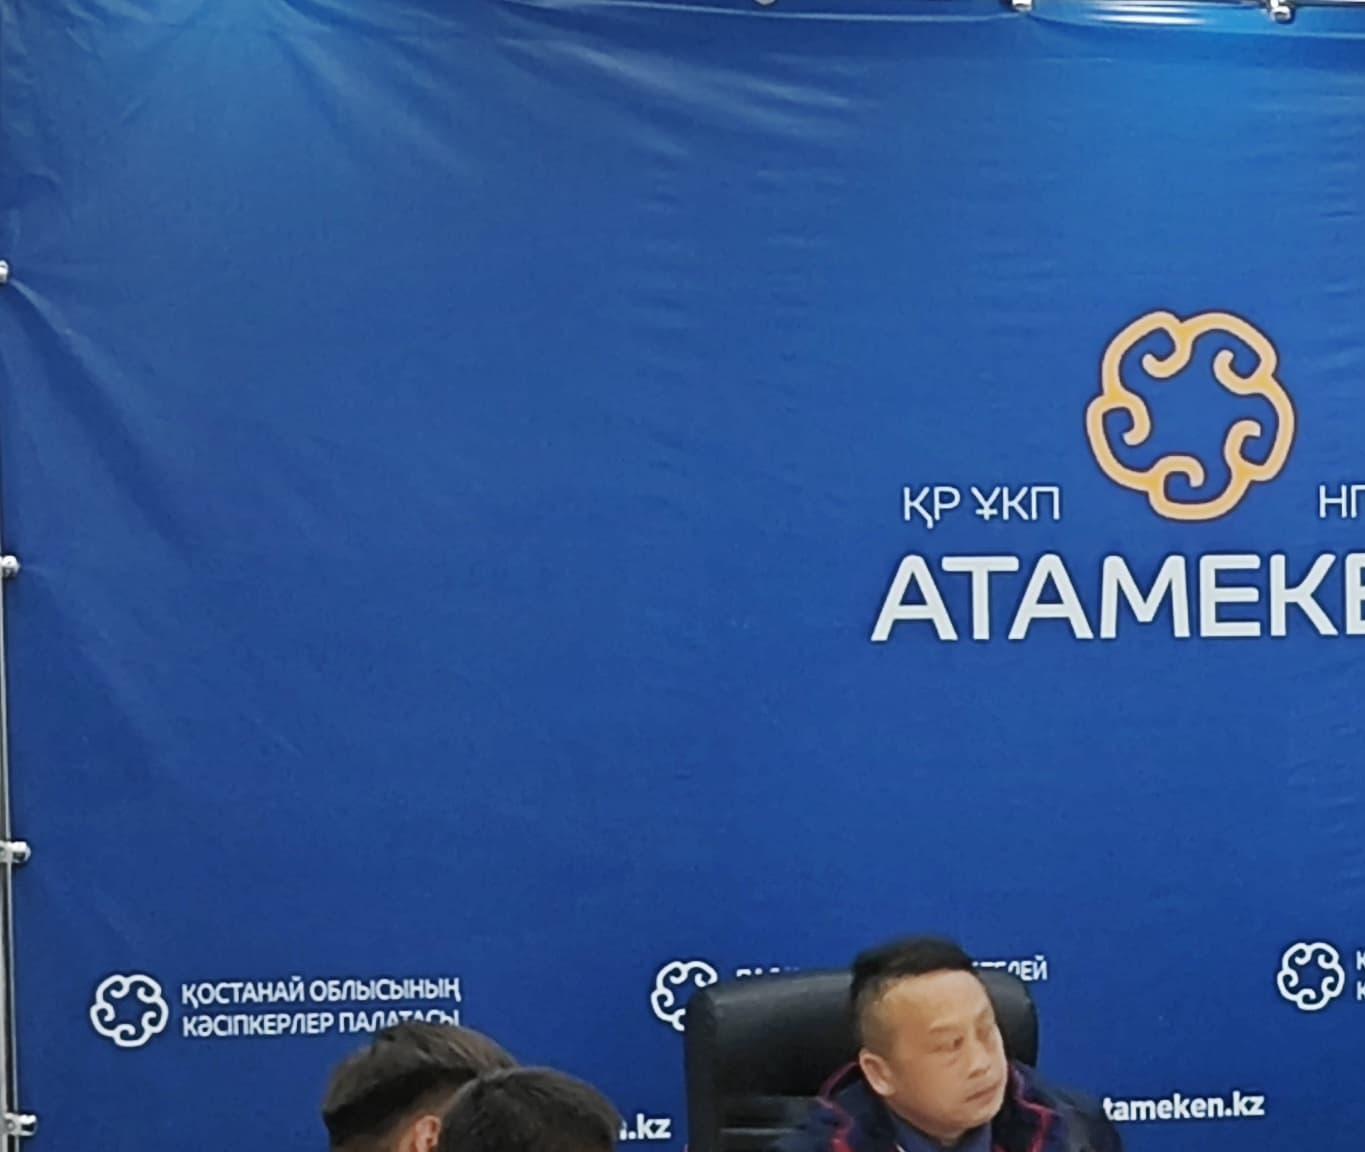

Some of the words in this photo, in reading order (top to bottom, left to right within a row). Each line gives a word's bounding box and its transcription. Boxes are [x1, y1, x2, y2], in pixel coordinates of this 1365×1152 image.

[903, 485, 961, 529] ҚР
[970, 485, 1061, 521] ҰКП
[181, 975, 305, 1009] ҚОСТАНАЙ
[309, 976, 462, 1003] ОБЛЫСЫНЫҢ
[182, 1012, 335, 1038] КӘСІПКЕРЛЕР
[1103, 1090, 1265, 1121] tameken.kz
